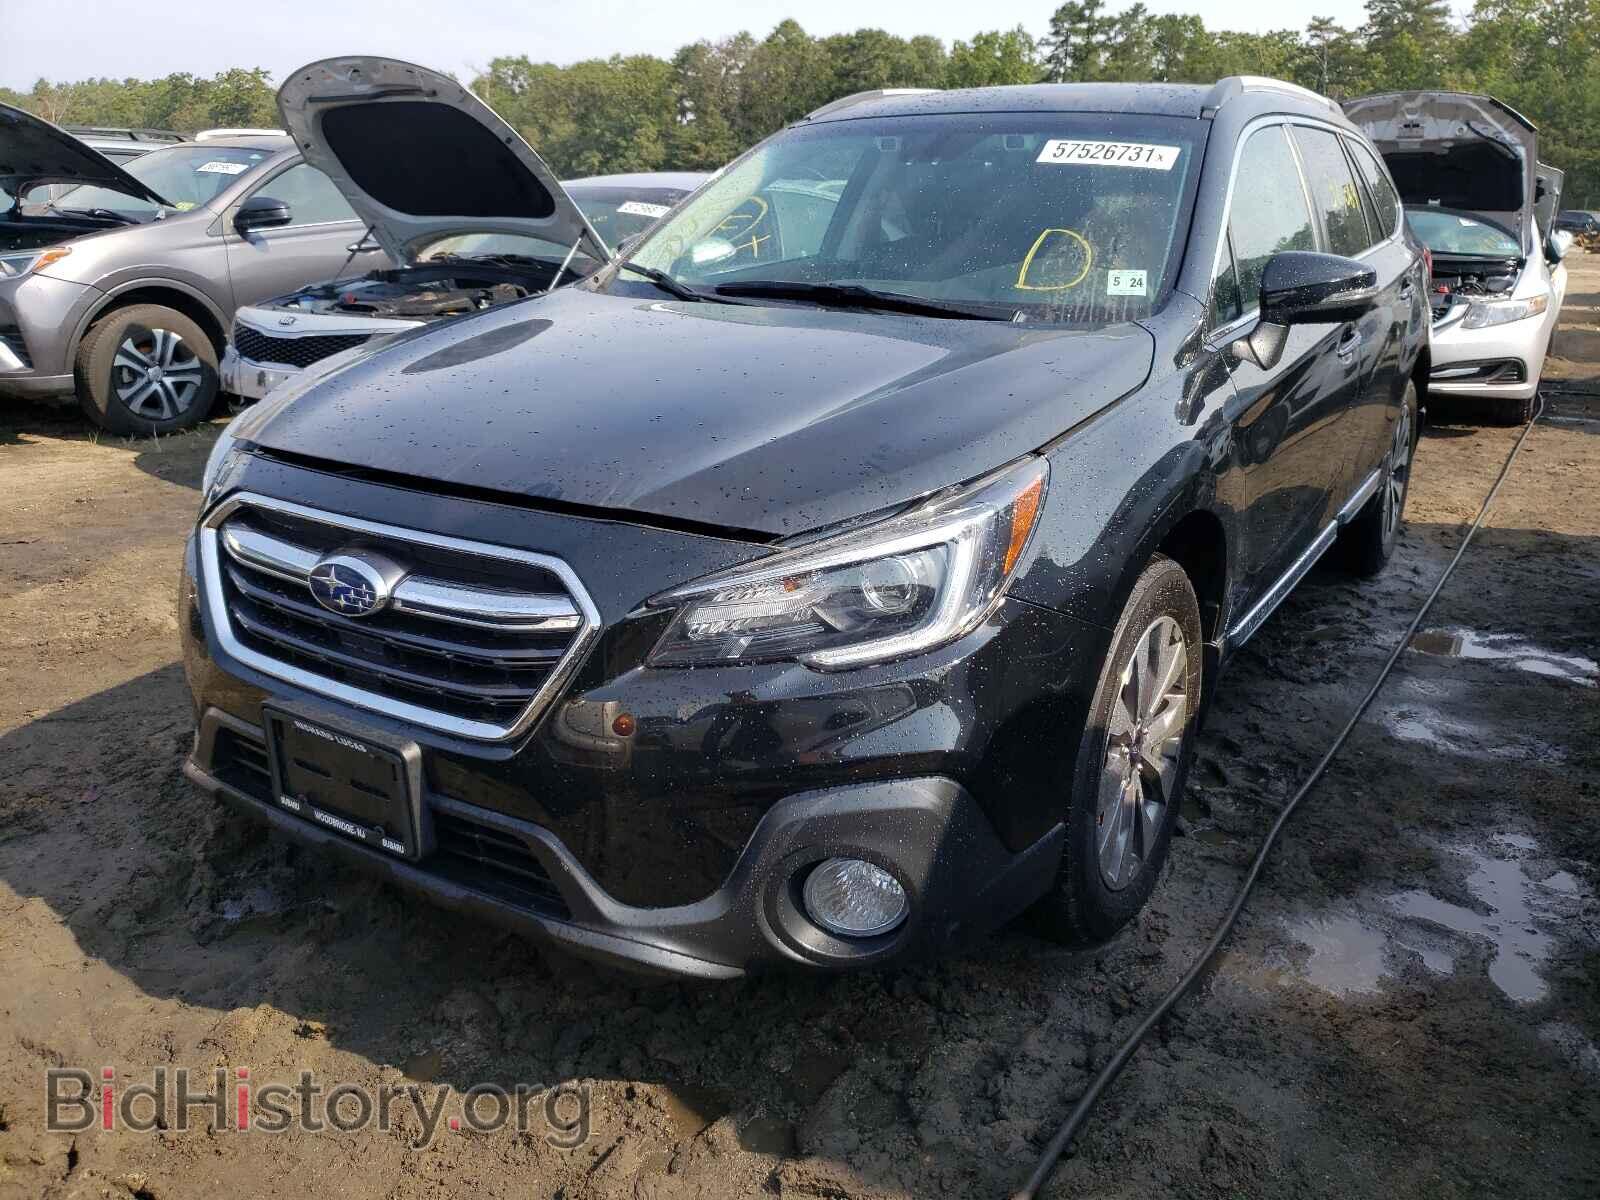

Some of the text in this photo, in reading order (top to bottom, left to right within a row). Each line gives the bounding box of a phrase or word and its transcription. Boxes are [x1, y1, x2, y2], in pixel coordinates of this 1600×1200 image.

[1112, 276, 1144, 288] 5 24
[334, 735, 367, 753] LUCAS
[382, 838, 405, 854] SUBARU
